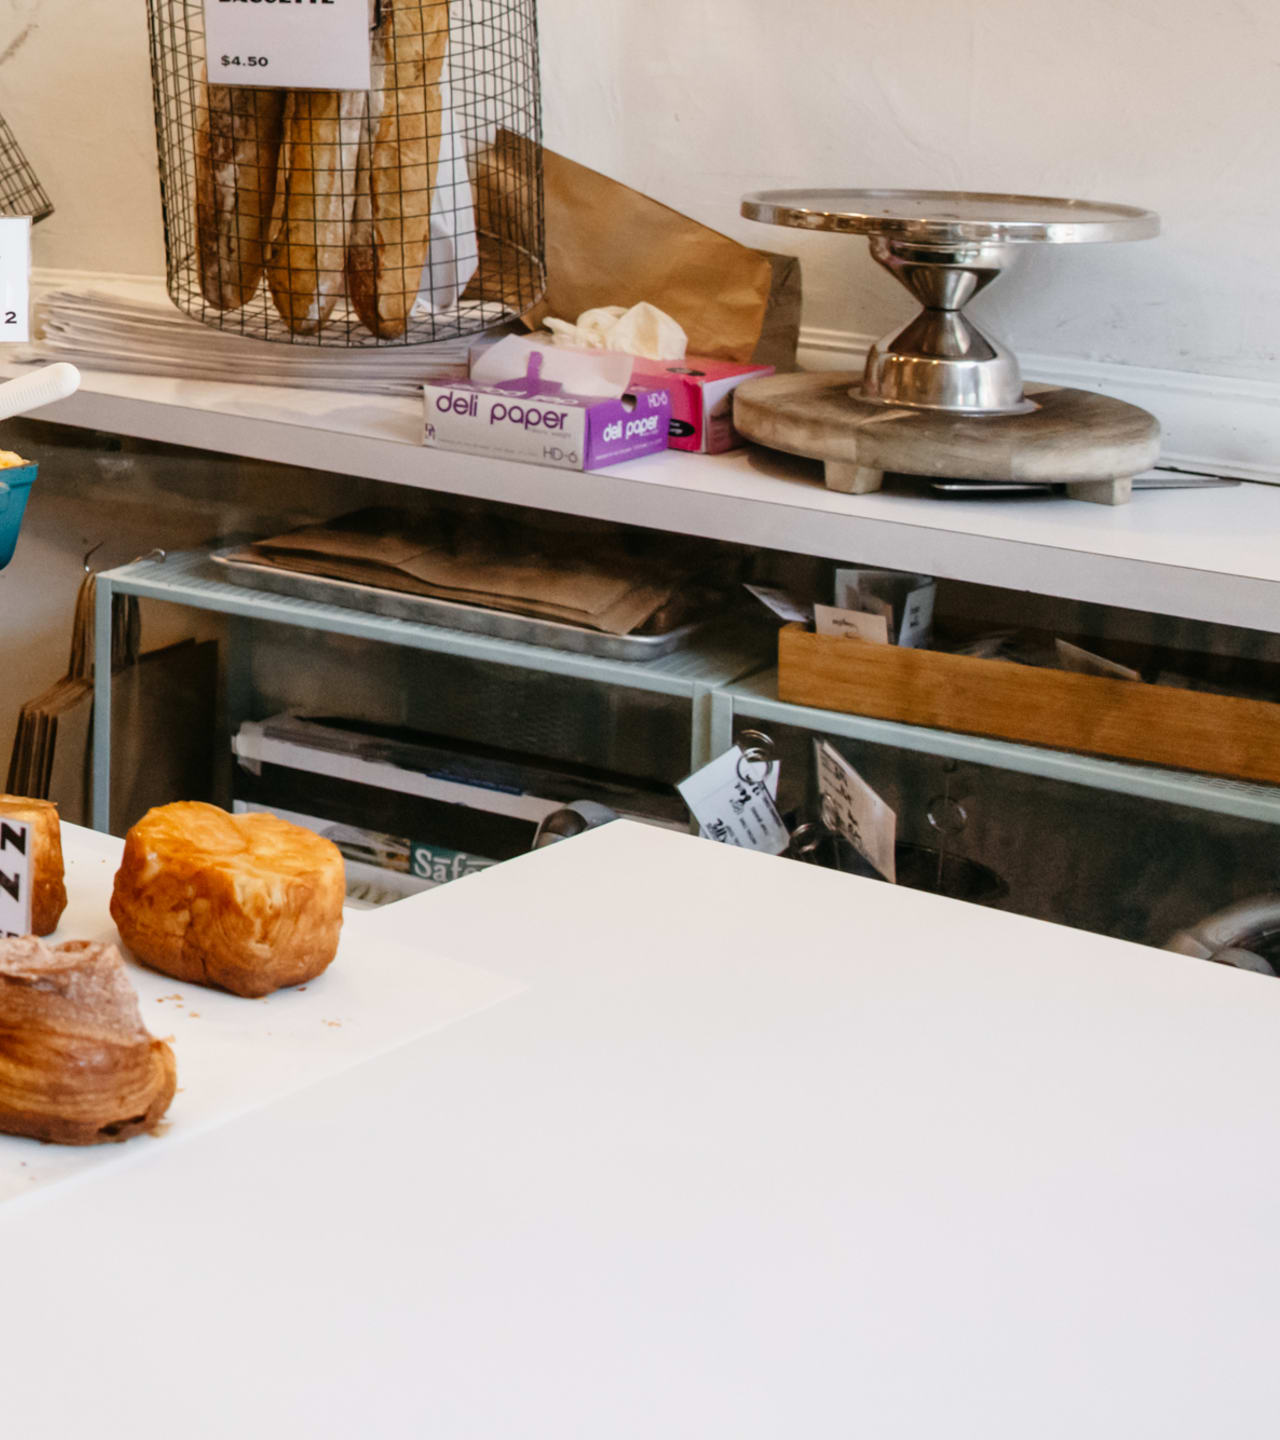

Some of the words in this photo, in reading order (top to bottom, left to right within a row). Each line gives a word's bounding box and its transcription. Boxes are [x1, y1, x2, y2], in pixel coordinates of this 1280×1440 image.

[221, 55, 268, 67] $4.50
[436, 391, 478, 417] deli
[490, 402, 569, 432] paper
[603, 420, 623, 442] deli
[625, 414, 659, 439] paper
[542, 446, 578, 464] HD-6
